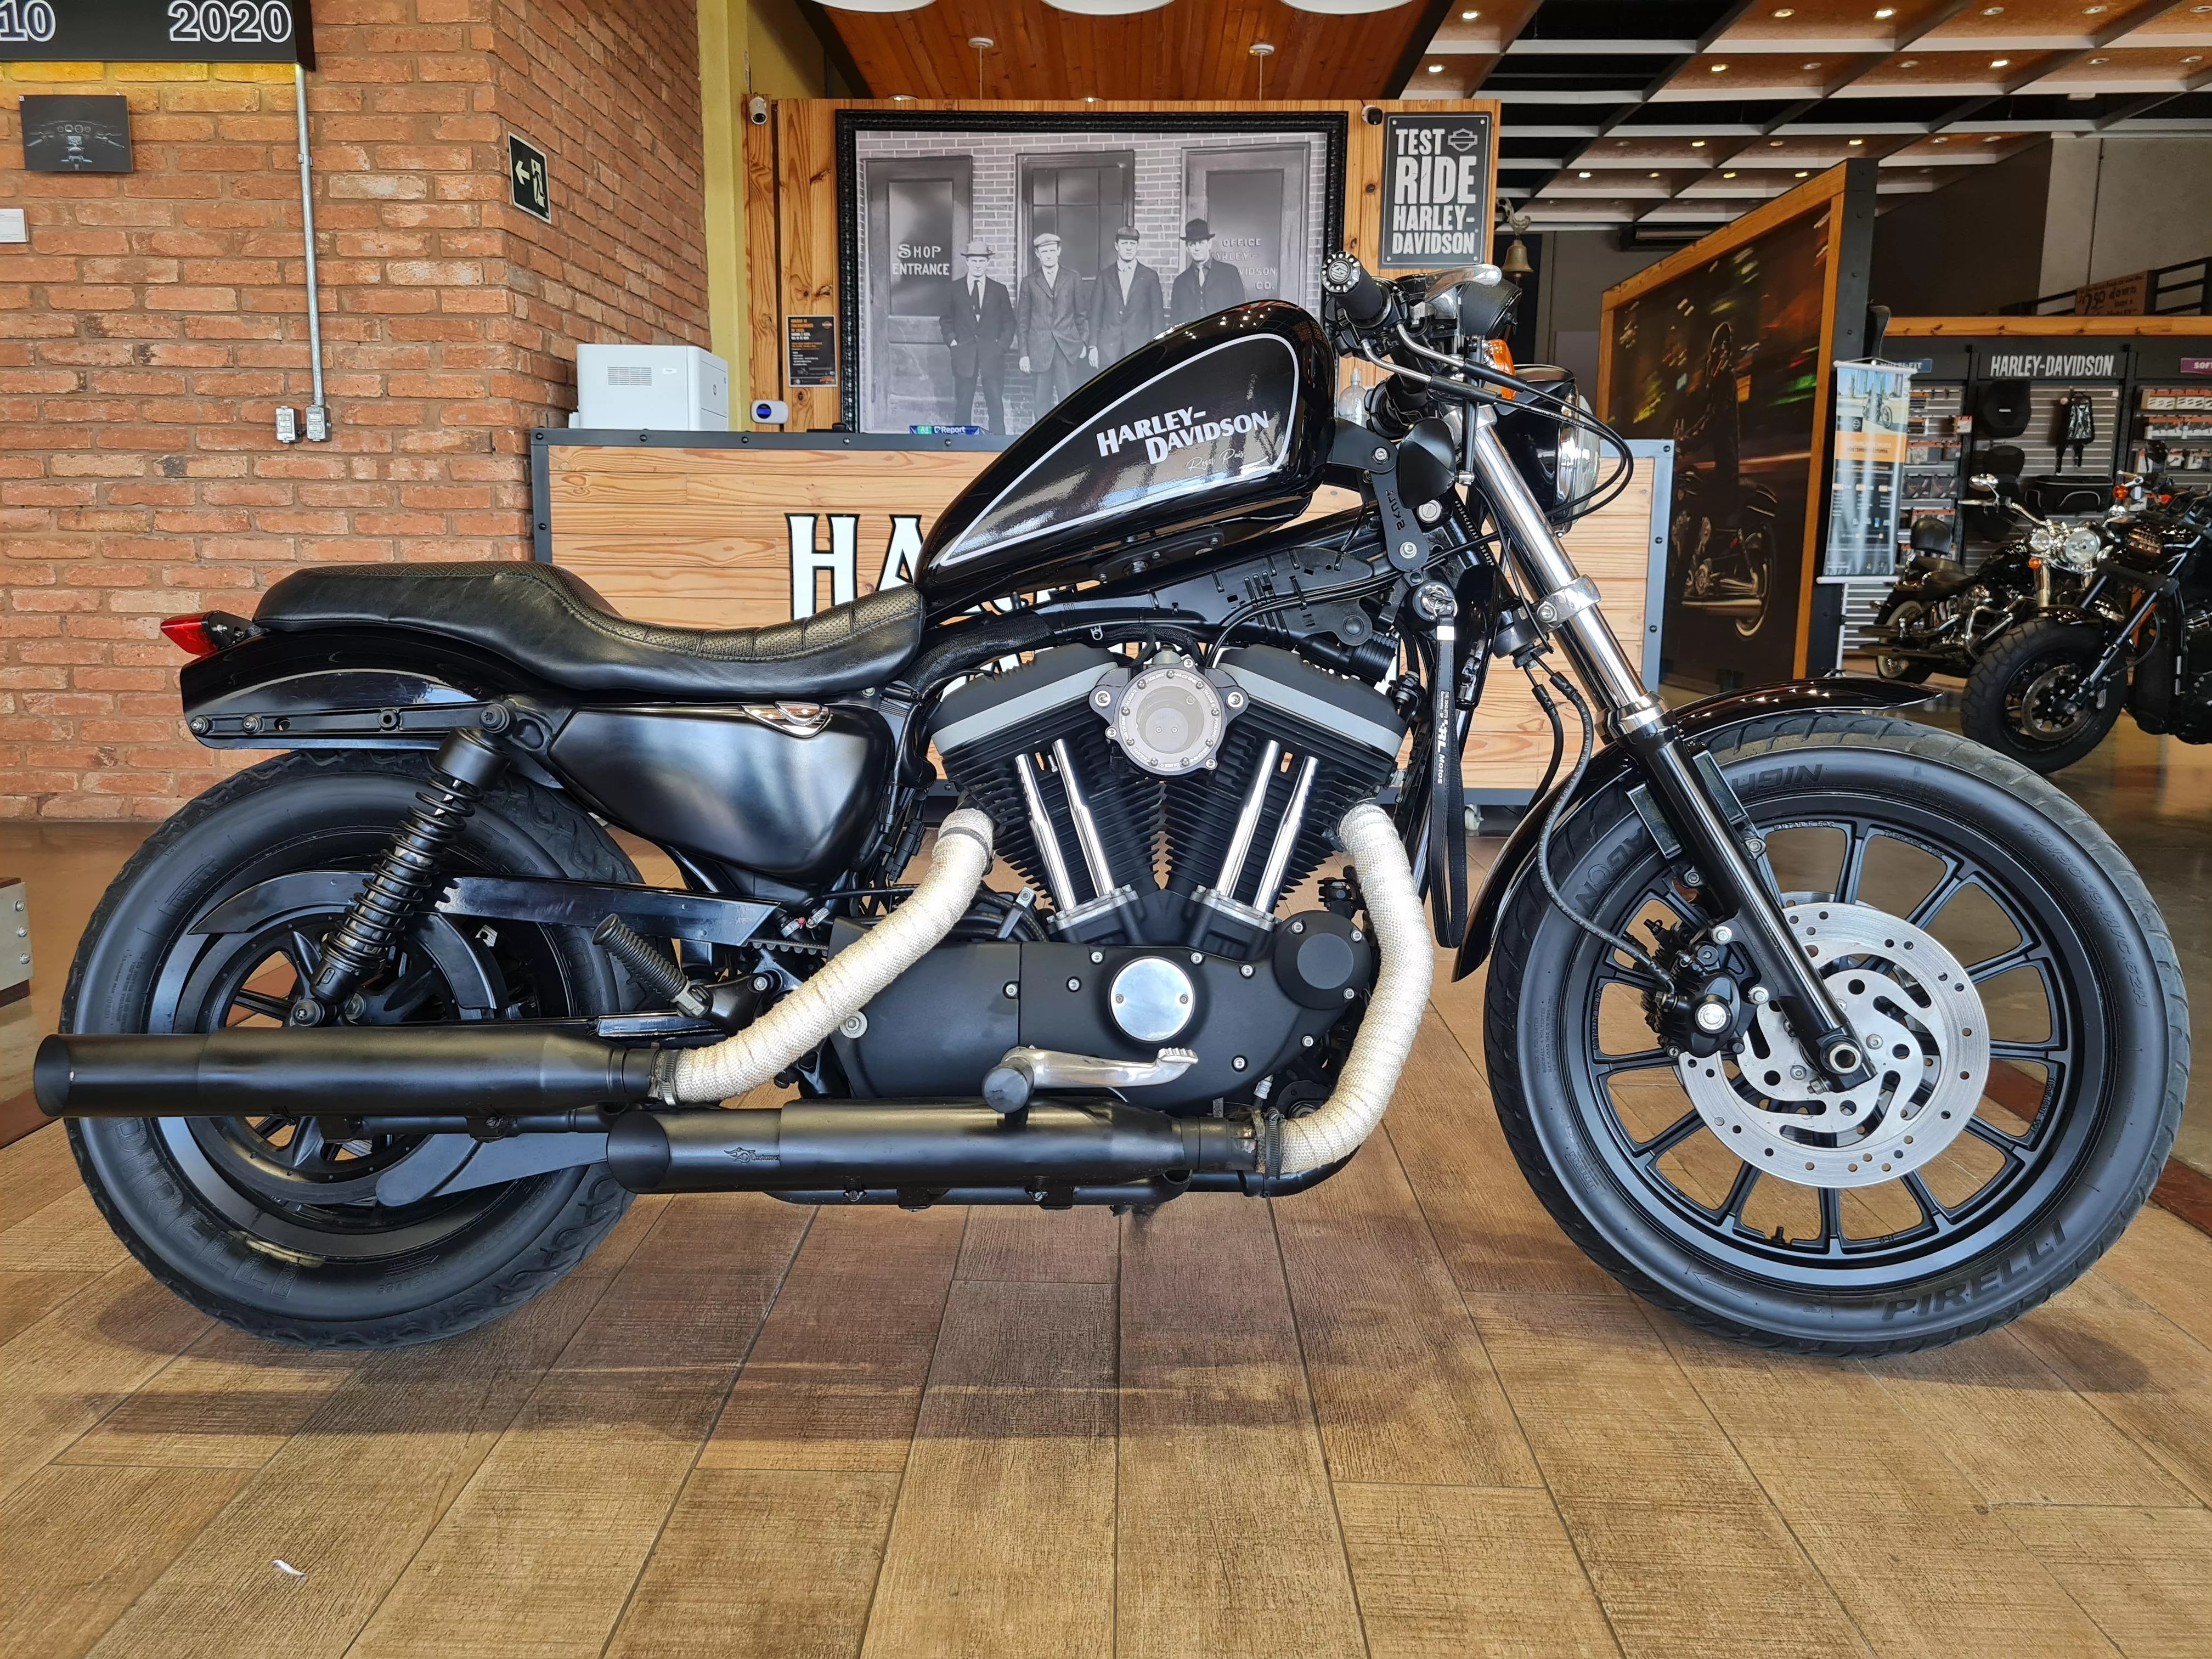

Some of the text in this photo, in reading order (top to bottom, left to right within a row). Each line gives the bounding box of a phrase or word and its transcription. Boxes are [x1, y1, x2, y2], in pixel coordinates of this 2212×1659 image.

[168, 0, 292, 43] 2020
[1396, 128, 1445, 156] TEST
[1396, 156, 1477, 205] RIDE
[1393, 205, 1474, 232] HARLEY-
[898, 243, 941, 259] SHOP
[1222, 238, 1262, 247] OFFICE
[1392, 232, 1475, 255] DAVIDSON
[1211, 252, 1259, 262] ARLEY-
[891, 263, 950, 276] ENTRANCE
[1238, 267, 1276, 276] VIDSON
[1255, 281, 1275, 291] CO.
[1991, 354, 2115, 377] HARLEY-DAVIDSON
[941, 426, 966, 434] Report
[1096, 406, 1206, 457] HARLEY-
[1144, 410, 1269, 465] DAVIDSON
[1881, 1219, 2068, 1323] PIRELLI
